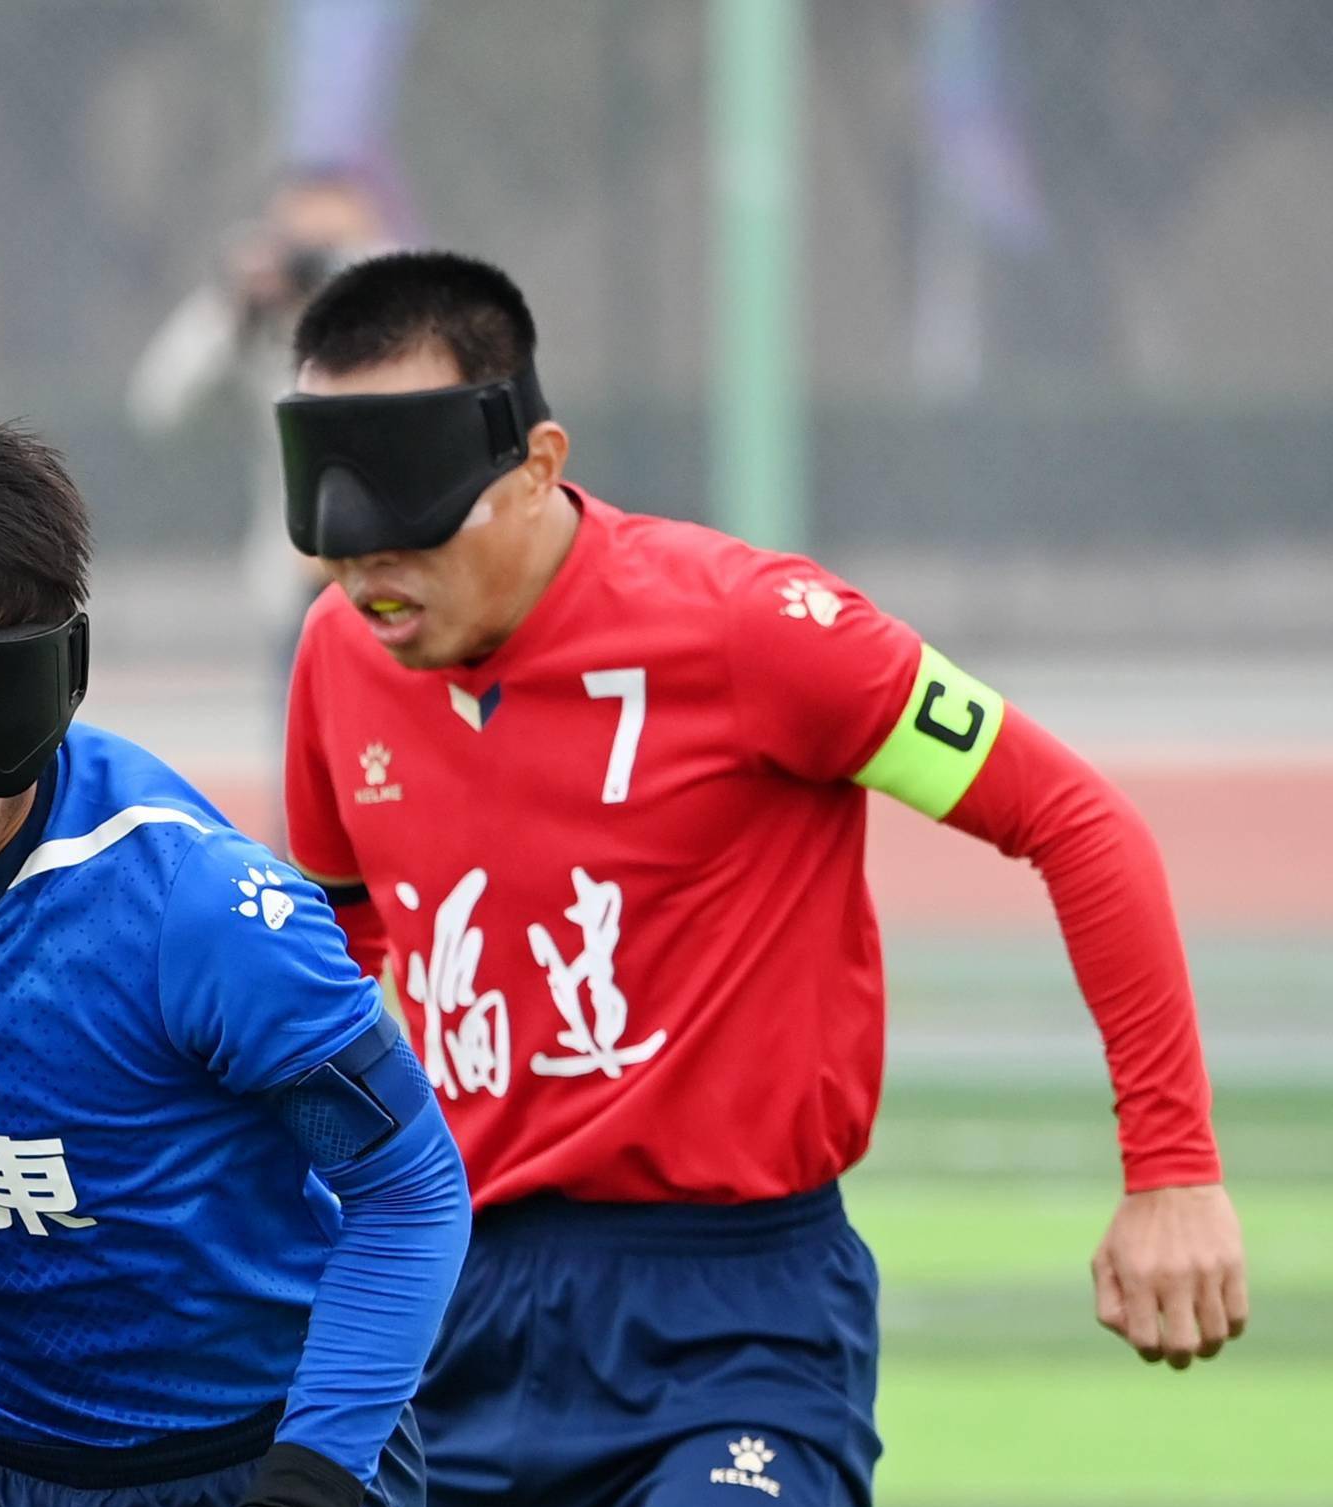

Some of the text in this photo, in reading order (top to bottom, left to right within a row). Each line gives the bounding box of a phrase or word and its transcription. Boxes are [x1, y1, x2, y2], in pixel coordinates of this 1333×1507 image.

[582, 667, 646, 805] 7
[914, 679, 985, 753] C
[709, 1467, 782, 1498] KELME
